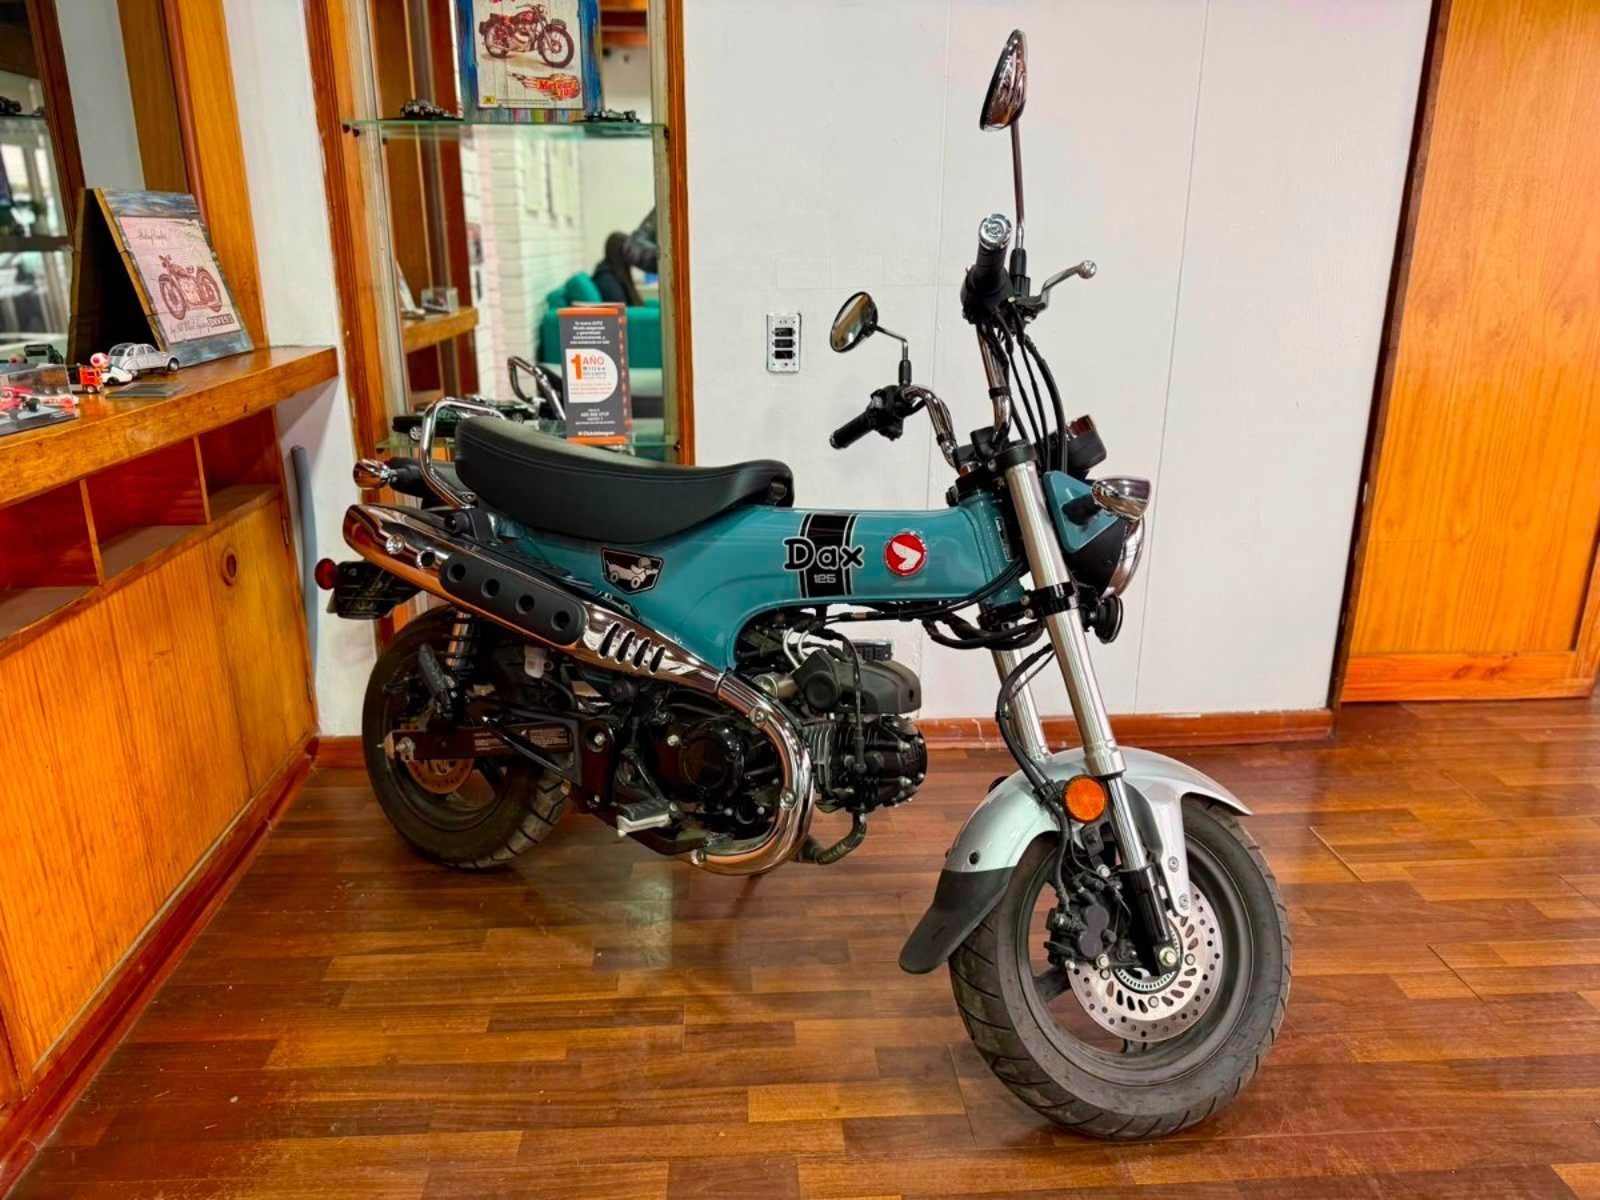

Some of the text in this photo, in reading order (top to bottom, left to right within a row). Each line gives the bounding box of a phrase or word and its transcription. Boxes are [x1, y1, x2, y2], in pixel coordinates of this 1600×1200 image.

[570, 354, 605, 380] 1 AÑO
[782, 536, 865, 572] Dax
[813, 573, 837, 584] 125
